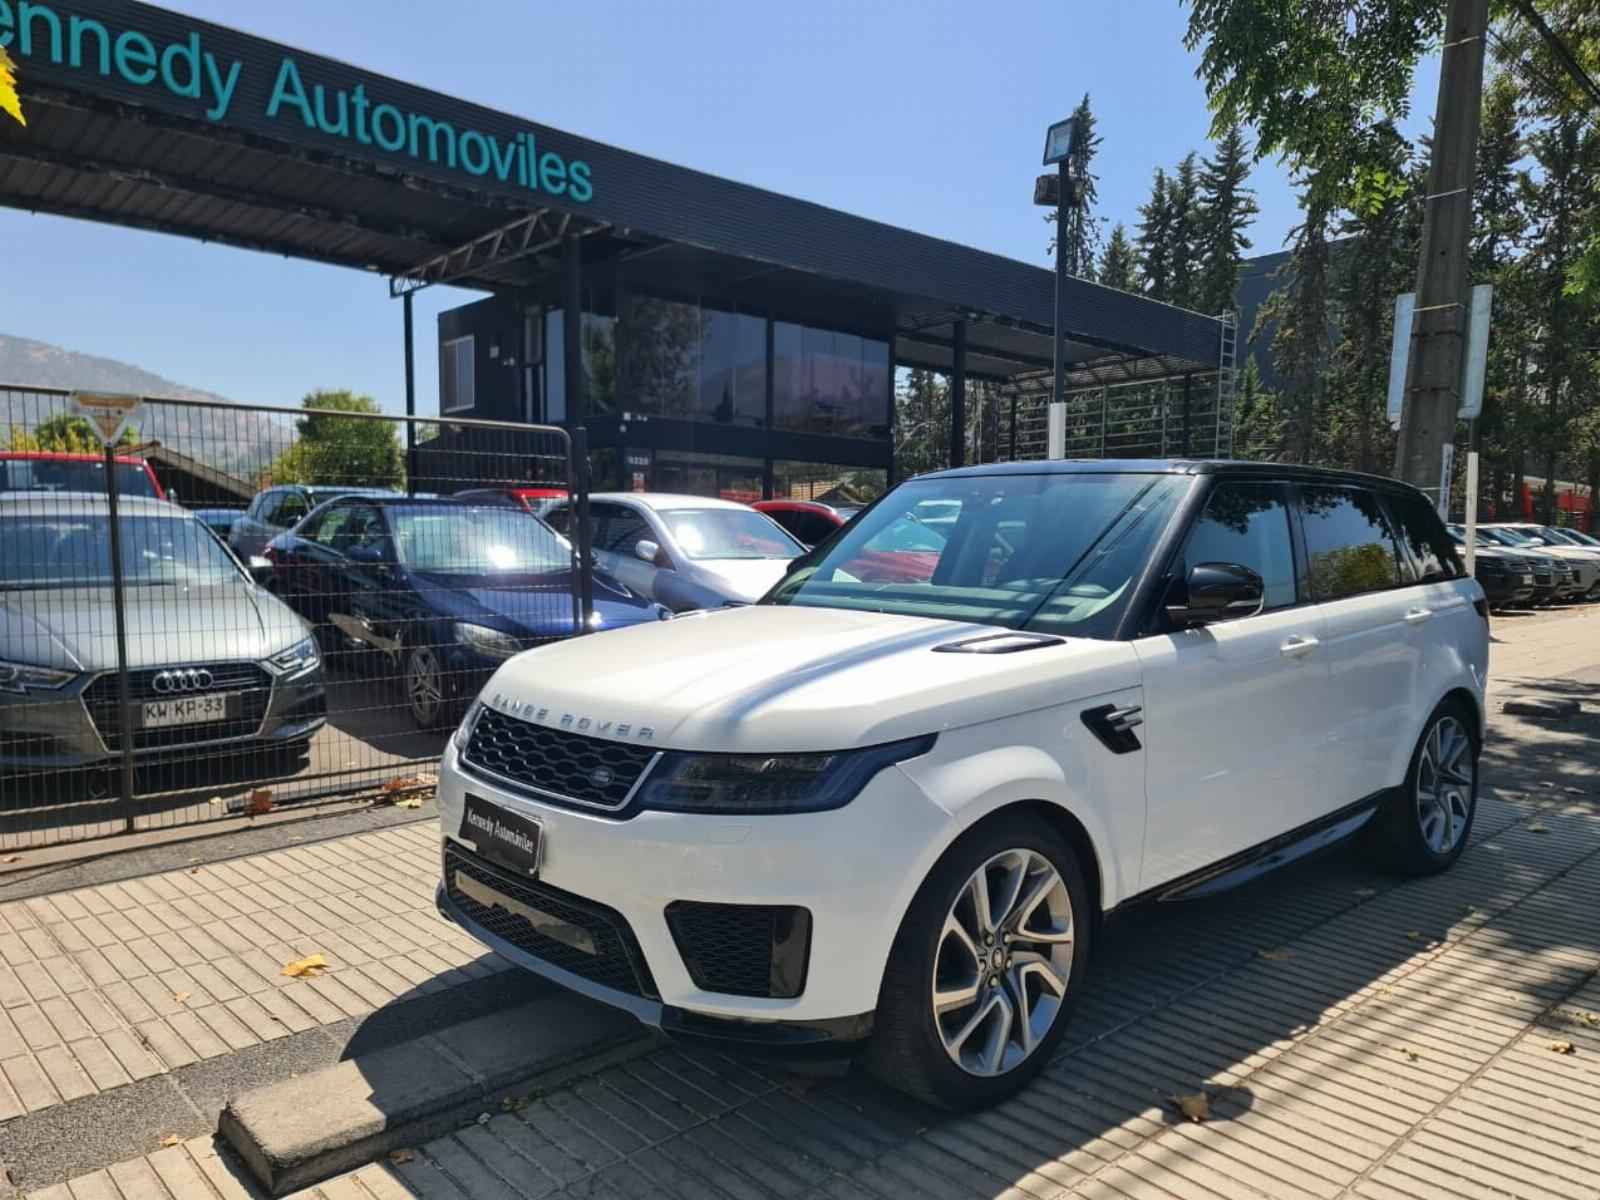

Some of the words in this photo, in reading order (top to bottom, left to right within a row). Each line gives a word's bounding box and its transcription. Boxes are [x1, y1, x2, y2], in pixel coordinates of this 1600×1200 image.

[0, 0, 242, 121] nnedy
[267, 58, 594, 203] Automoviles
[492, 693, 549, 720] RANGE
[560, 713, 656, 741] ROVER
[467, 807, 494, 837] Kennedy
